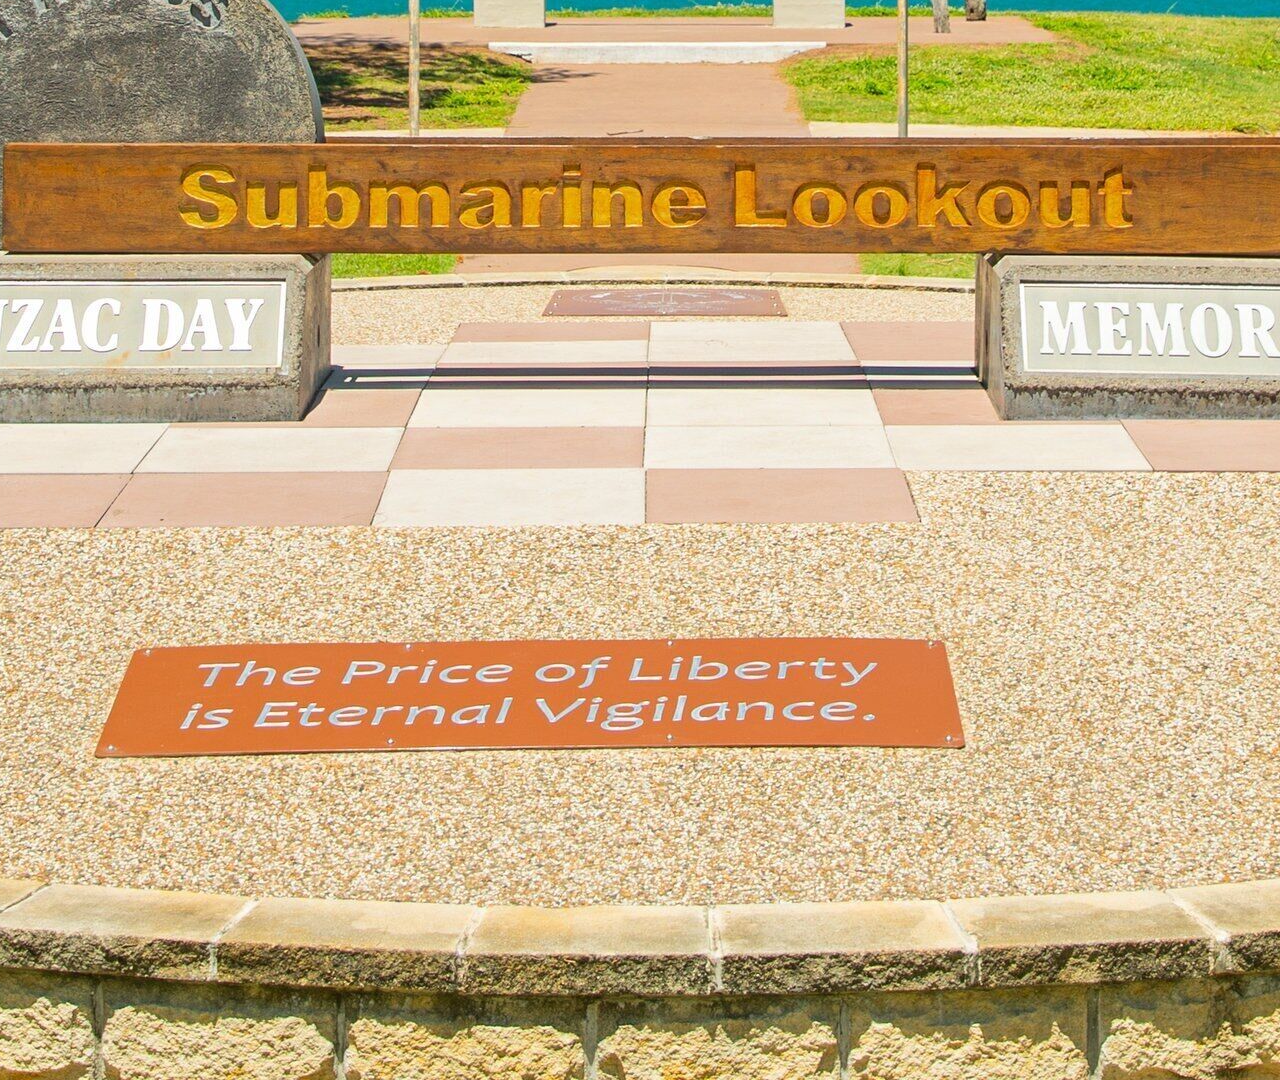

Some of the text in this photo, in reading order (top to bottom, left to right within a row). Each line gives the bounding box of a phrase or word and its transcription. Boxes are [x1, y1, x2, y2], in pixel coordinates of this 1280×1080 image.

[178, 162, 1134, 230] Submarine Lookout
[138, 297, 265, 353] DAY
[197, 655, 878, 689] The Price of Liberty
[179, 695, 876, 732] is Eternal Vigilance.
